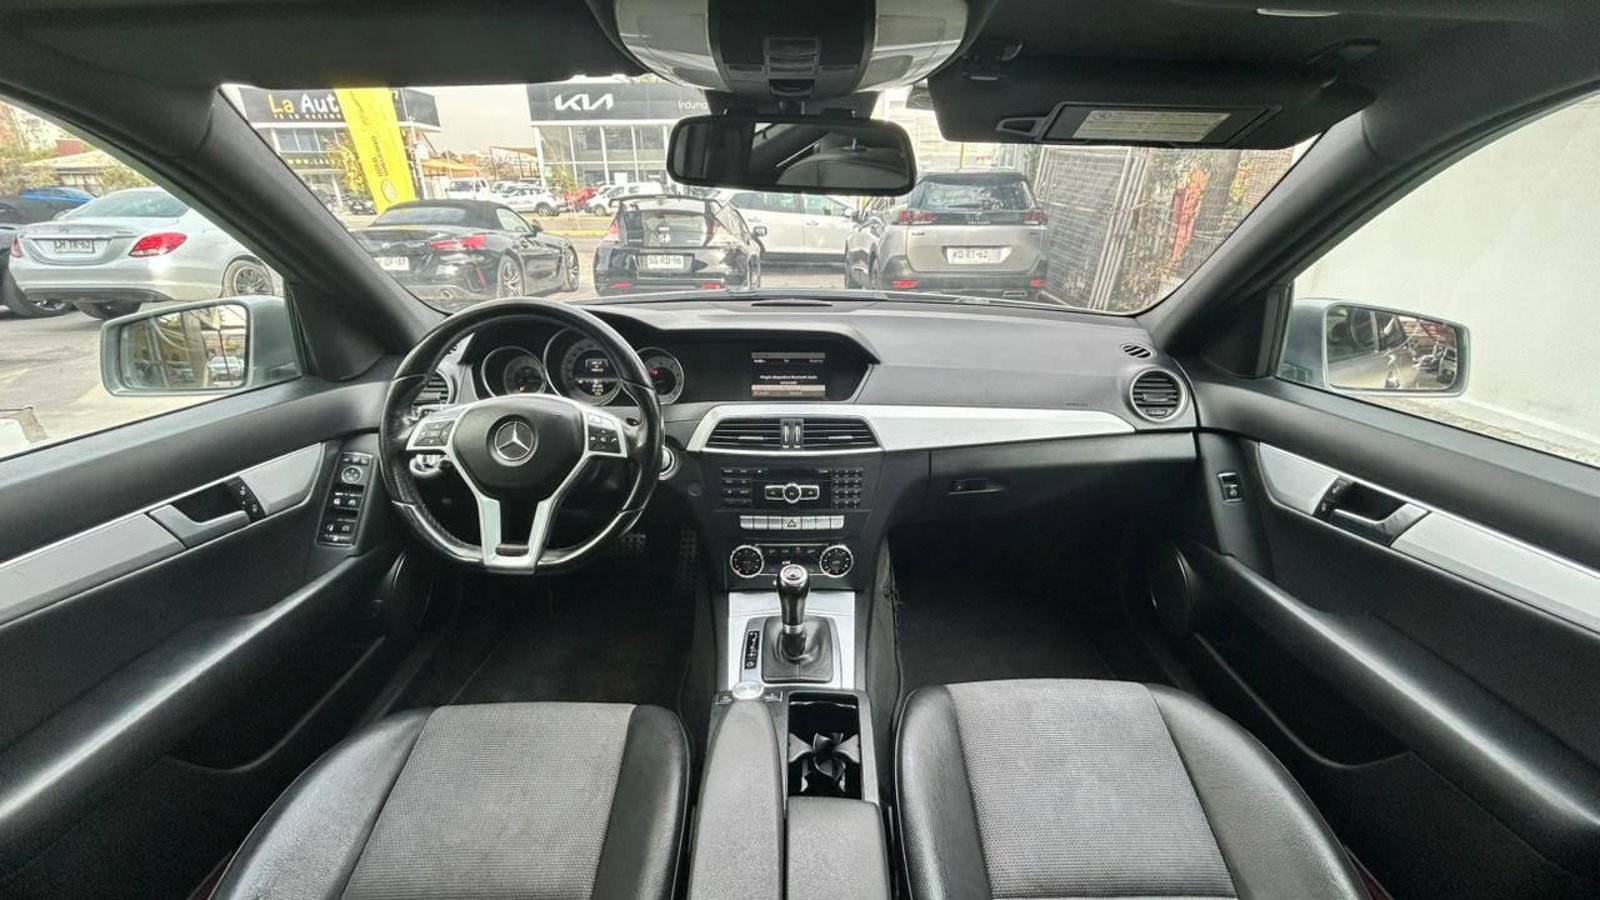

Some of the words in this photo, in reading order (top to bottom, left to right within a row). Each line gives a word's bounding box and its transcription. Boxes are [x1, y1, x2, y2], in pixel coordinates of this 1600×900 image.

[267, 93, 295, 114] La
[301, 92, 340, 114] Aut
[554, 93, 614, 111] KIA
